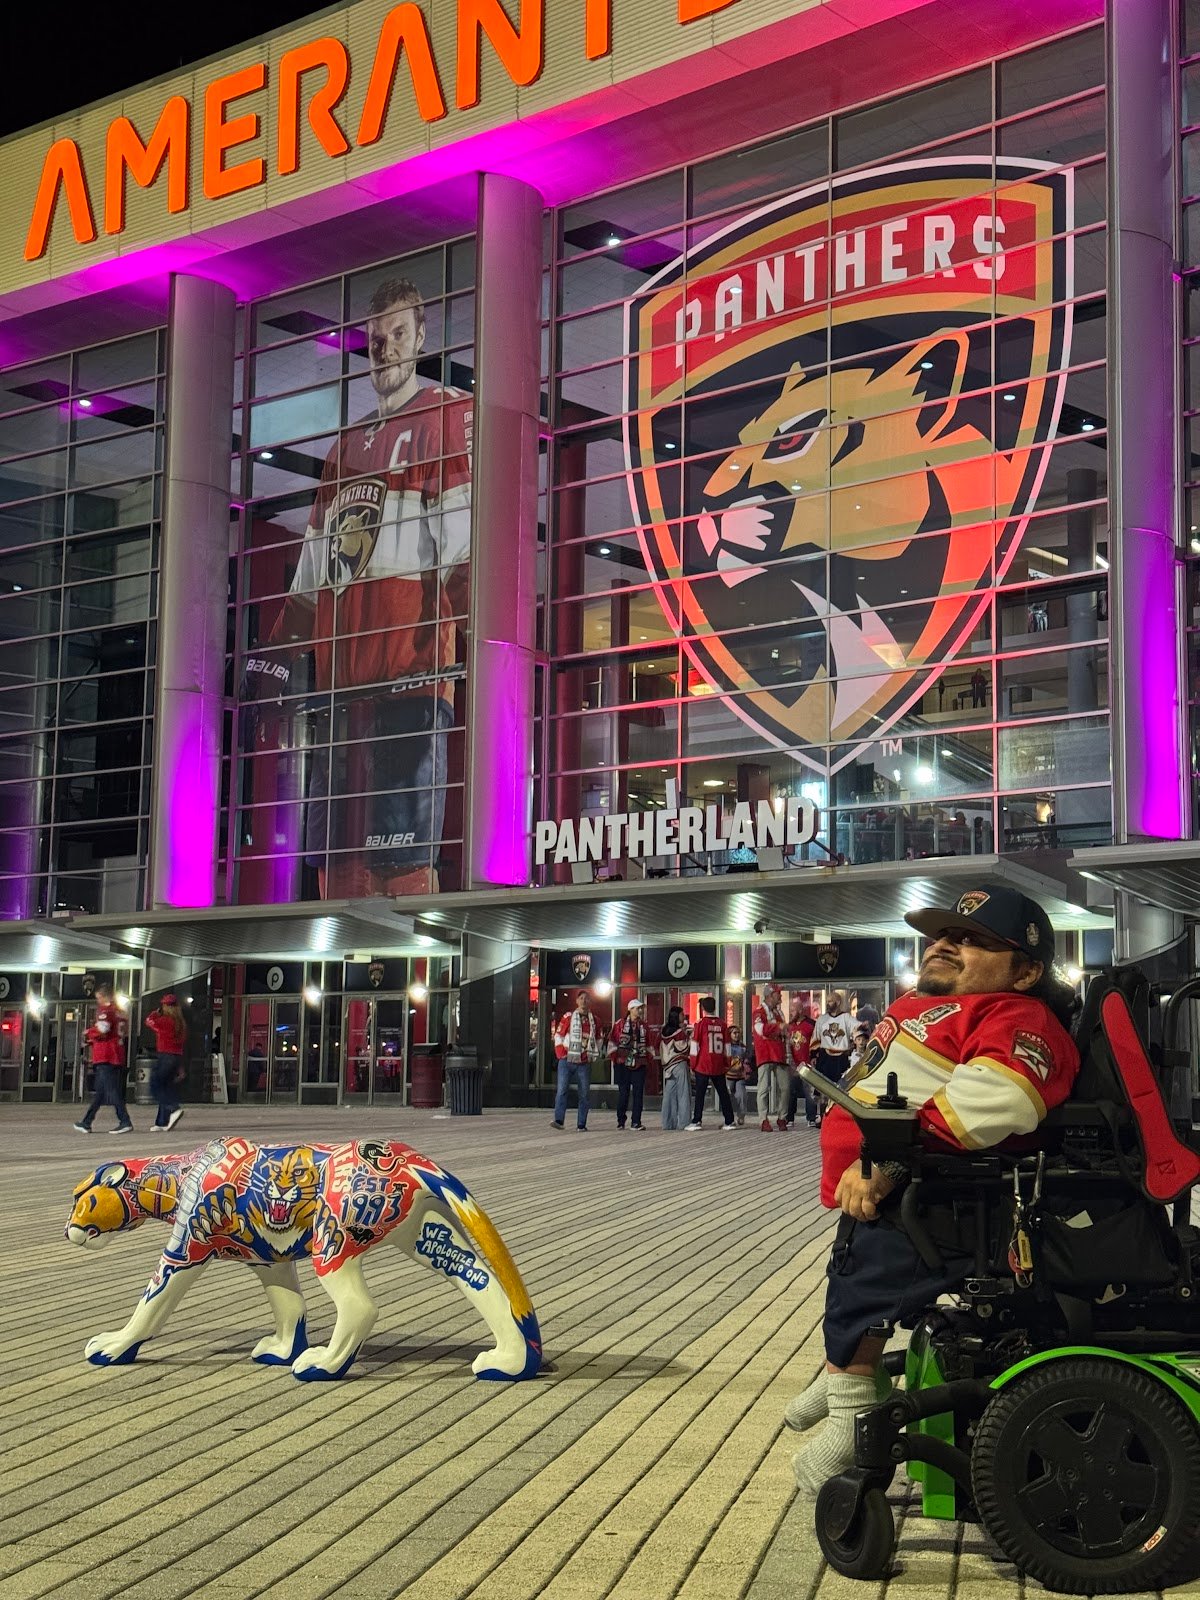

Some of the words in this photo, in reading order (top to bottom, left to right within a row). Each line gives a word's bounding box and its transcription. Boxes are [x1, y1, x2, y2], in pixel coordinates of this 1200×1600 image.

[674, 214, 1006, 369] PANTHERS
[388, 428, 412, 475] C
[535, 797, 818, 865] PANTHERLAND
[708, 1031, 724, 1054] 16
[352, 1176, 391, 1194] EST
[340, 1191, 402, 1226] 1993
[425, 1225, 449, 1242] WE
[421, 1240, 474, 1267] APOLOGIZE
[436, 1255, 448, 1268] TO
[447, 1261, 465, 1274] NO
[465, 1268, 487, 1285] ONE
